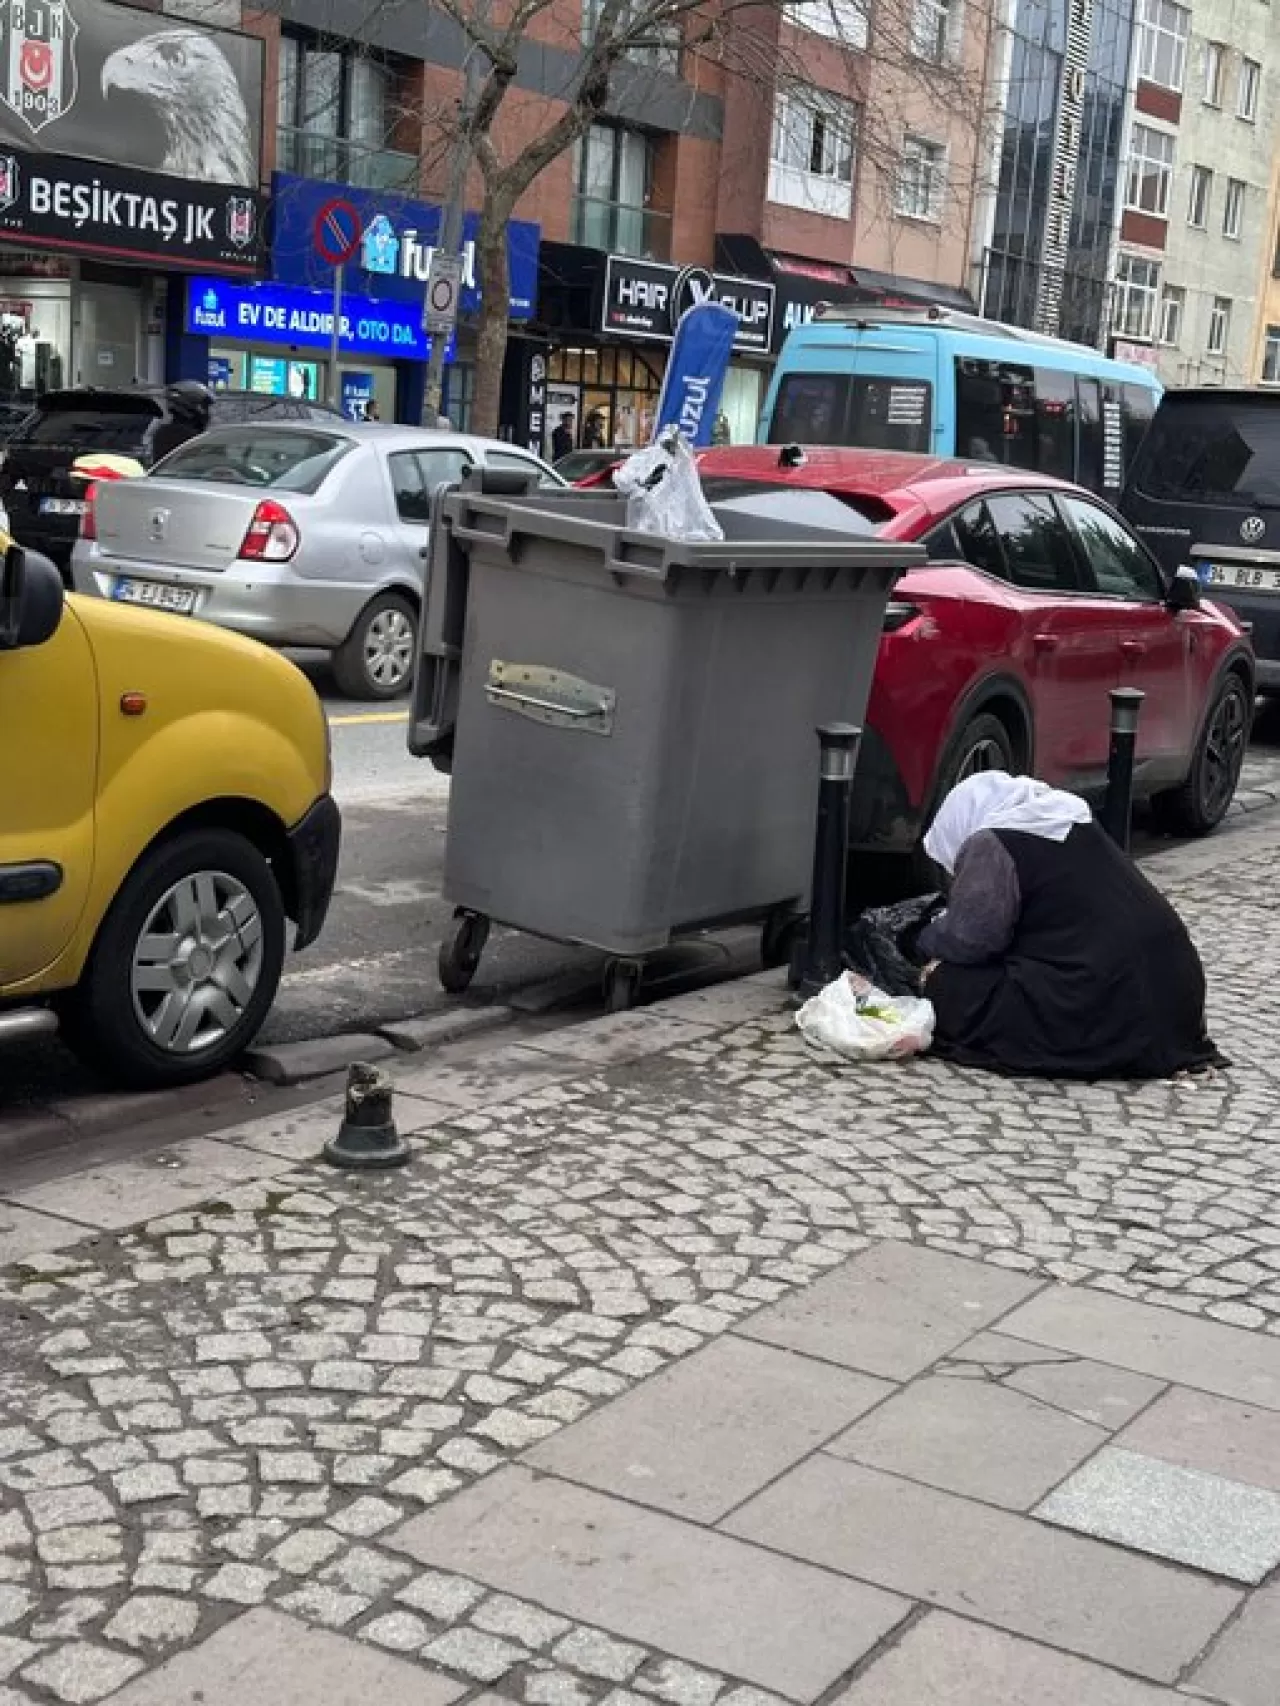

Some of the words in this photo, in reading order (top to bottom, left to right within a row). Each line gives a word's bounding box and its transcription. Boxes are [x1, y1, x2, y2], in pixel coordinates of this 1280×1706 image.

[30, 177, 178, 242] BEŞİKTAŞ
[183, 203, 216, 244] JK
[618, 277, 669, 311] HAIR
[238, 302, 261, 326] EV
[264, 305, 286, 329] DE
[358, 318, 389, 341] OTO
